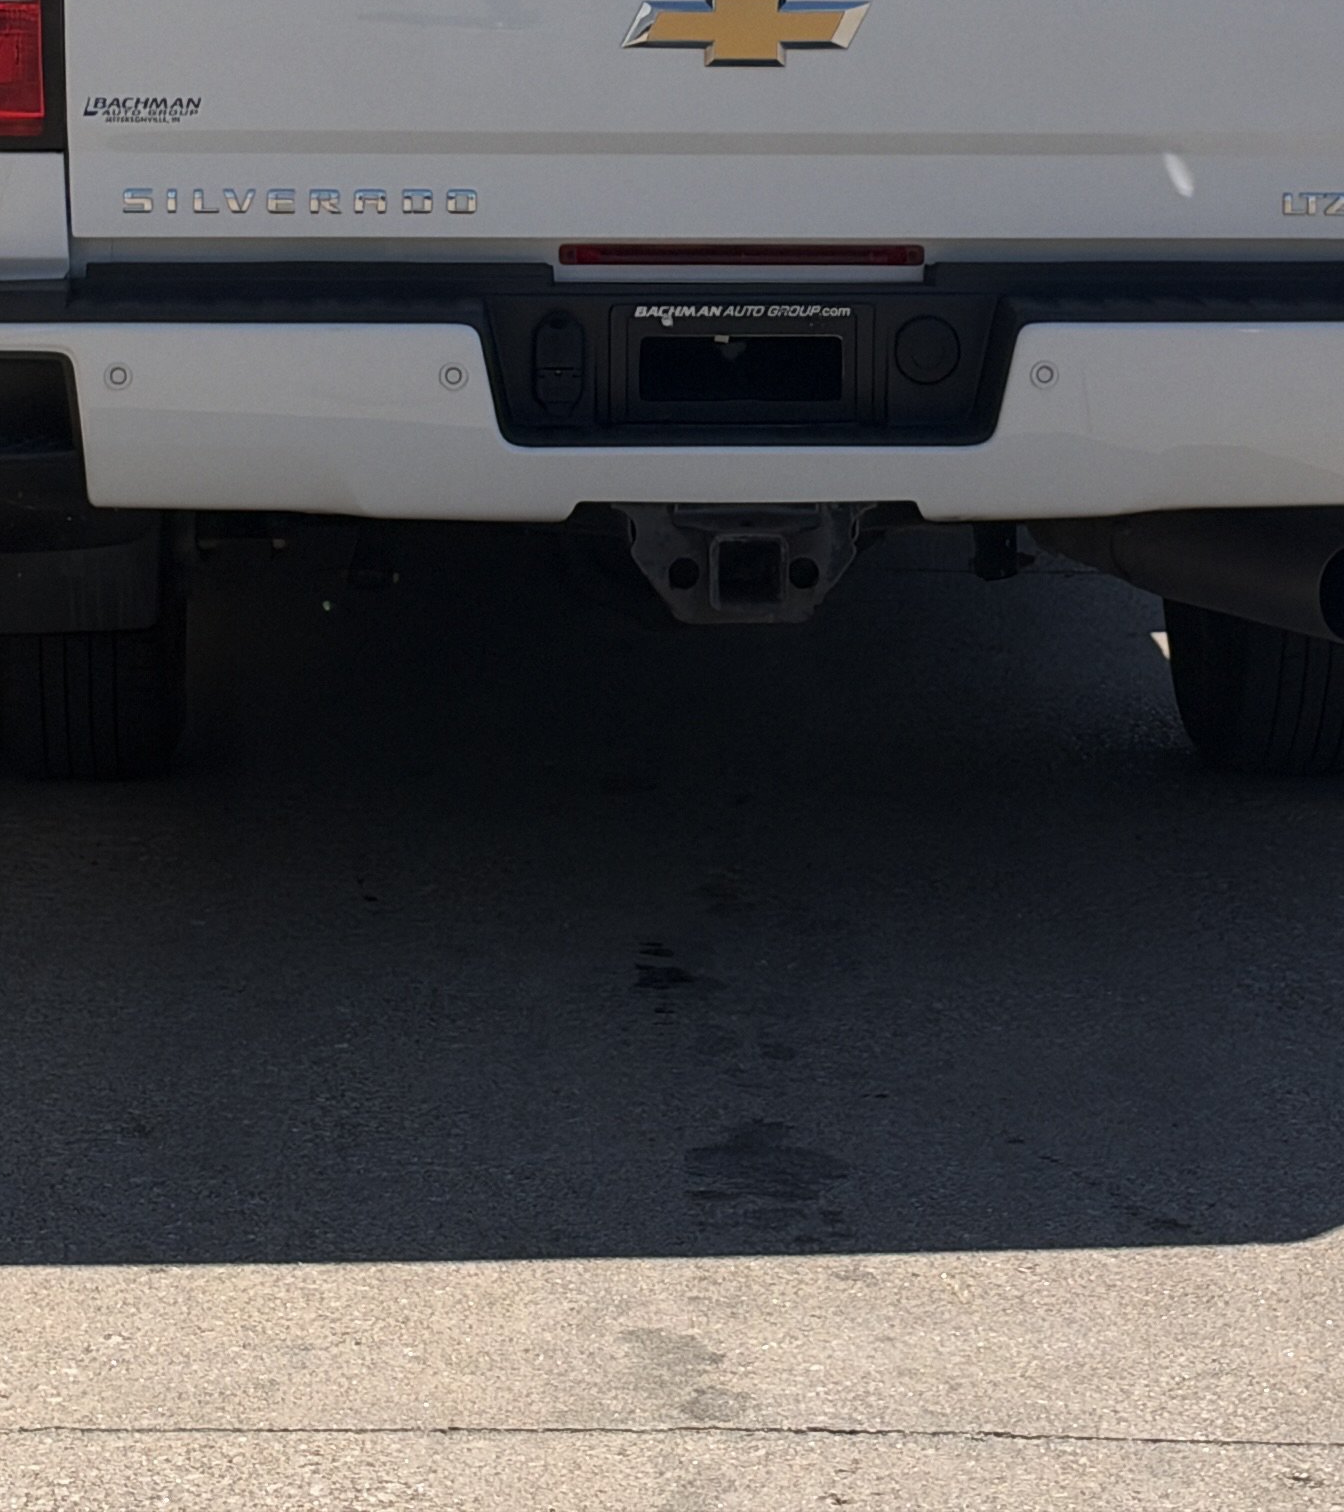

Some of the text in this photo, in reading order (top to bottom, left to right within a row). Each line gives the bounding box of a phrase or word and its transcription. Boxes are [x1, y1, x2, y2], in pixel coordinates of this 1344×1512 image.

[93, 96, 202, 109] BACHMAN
[121, 188, 478, 214] SILVERADO
[634, 305, 851, 318] BACHMAN AUTO GROUP.com
